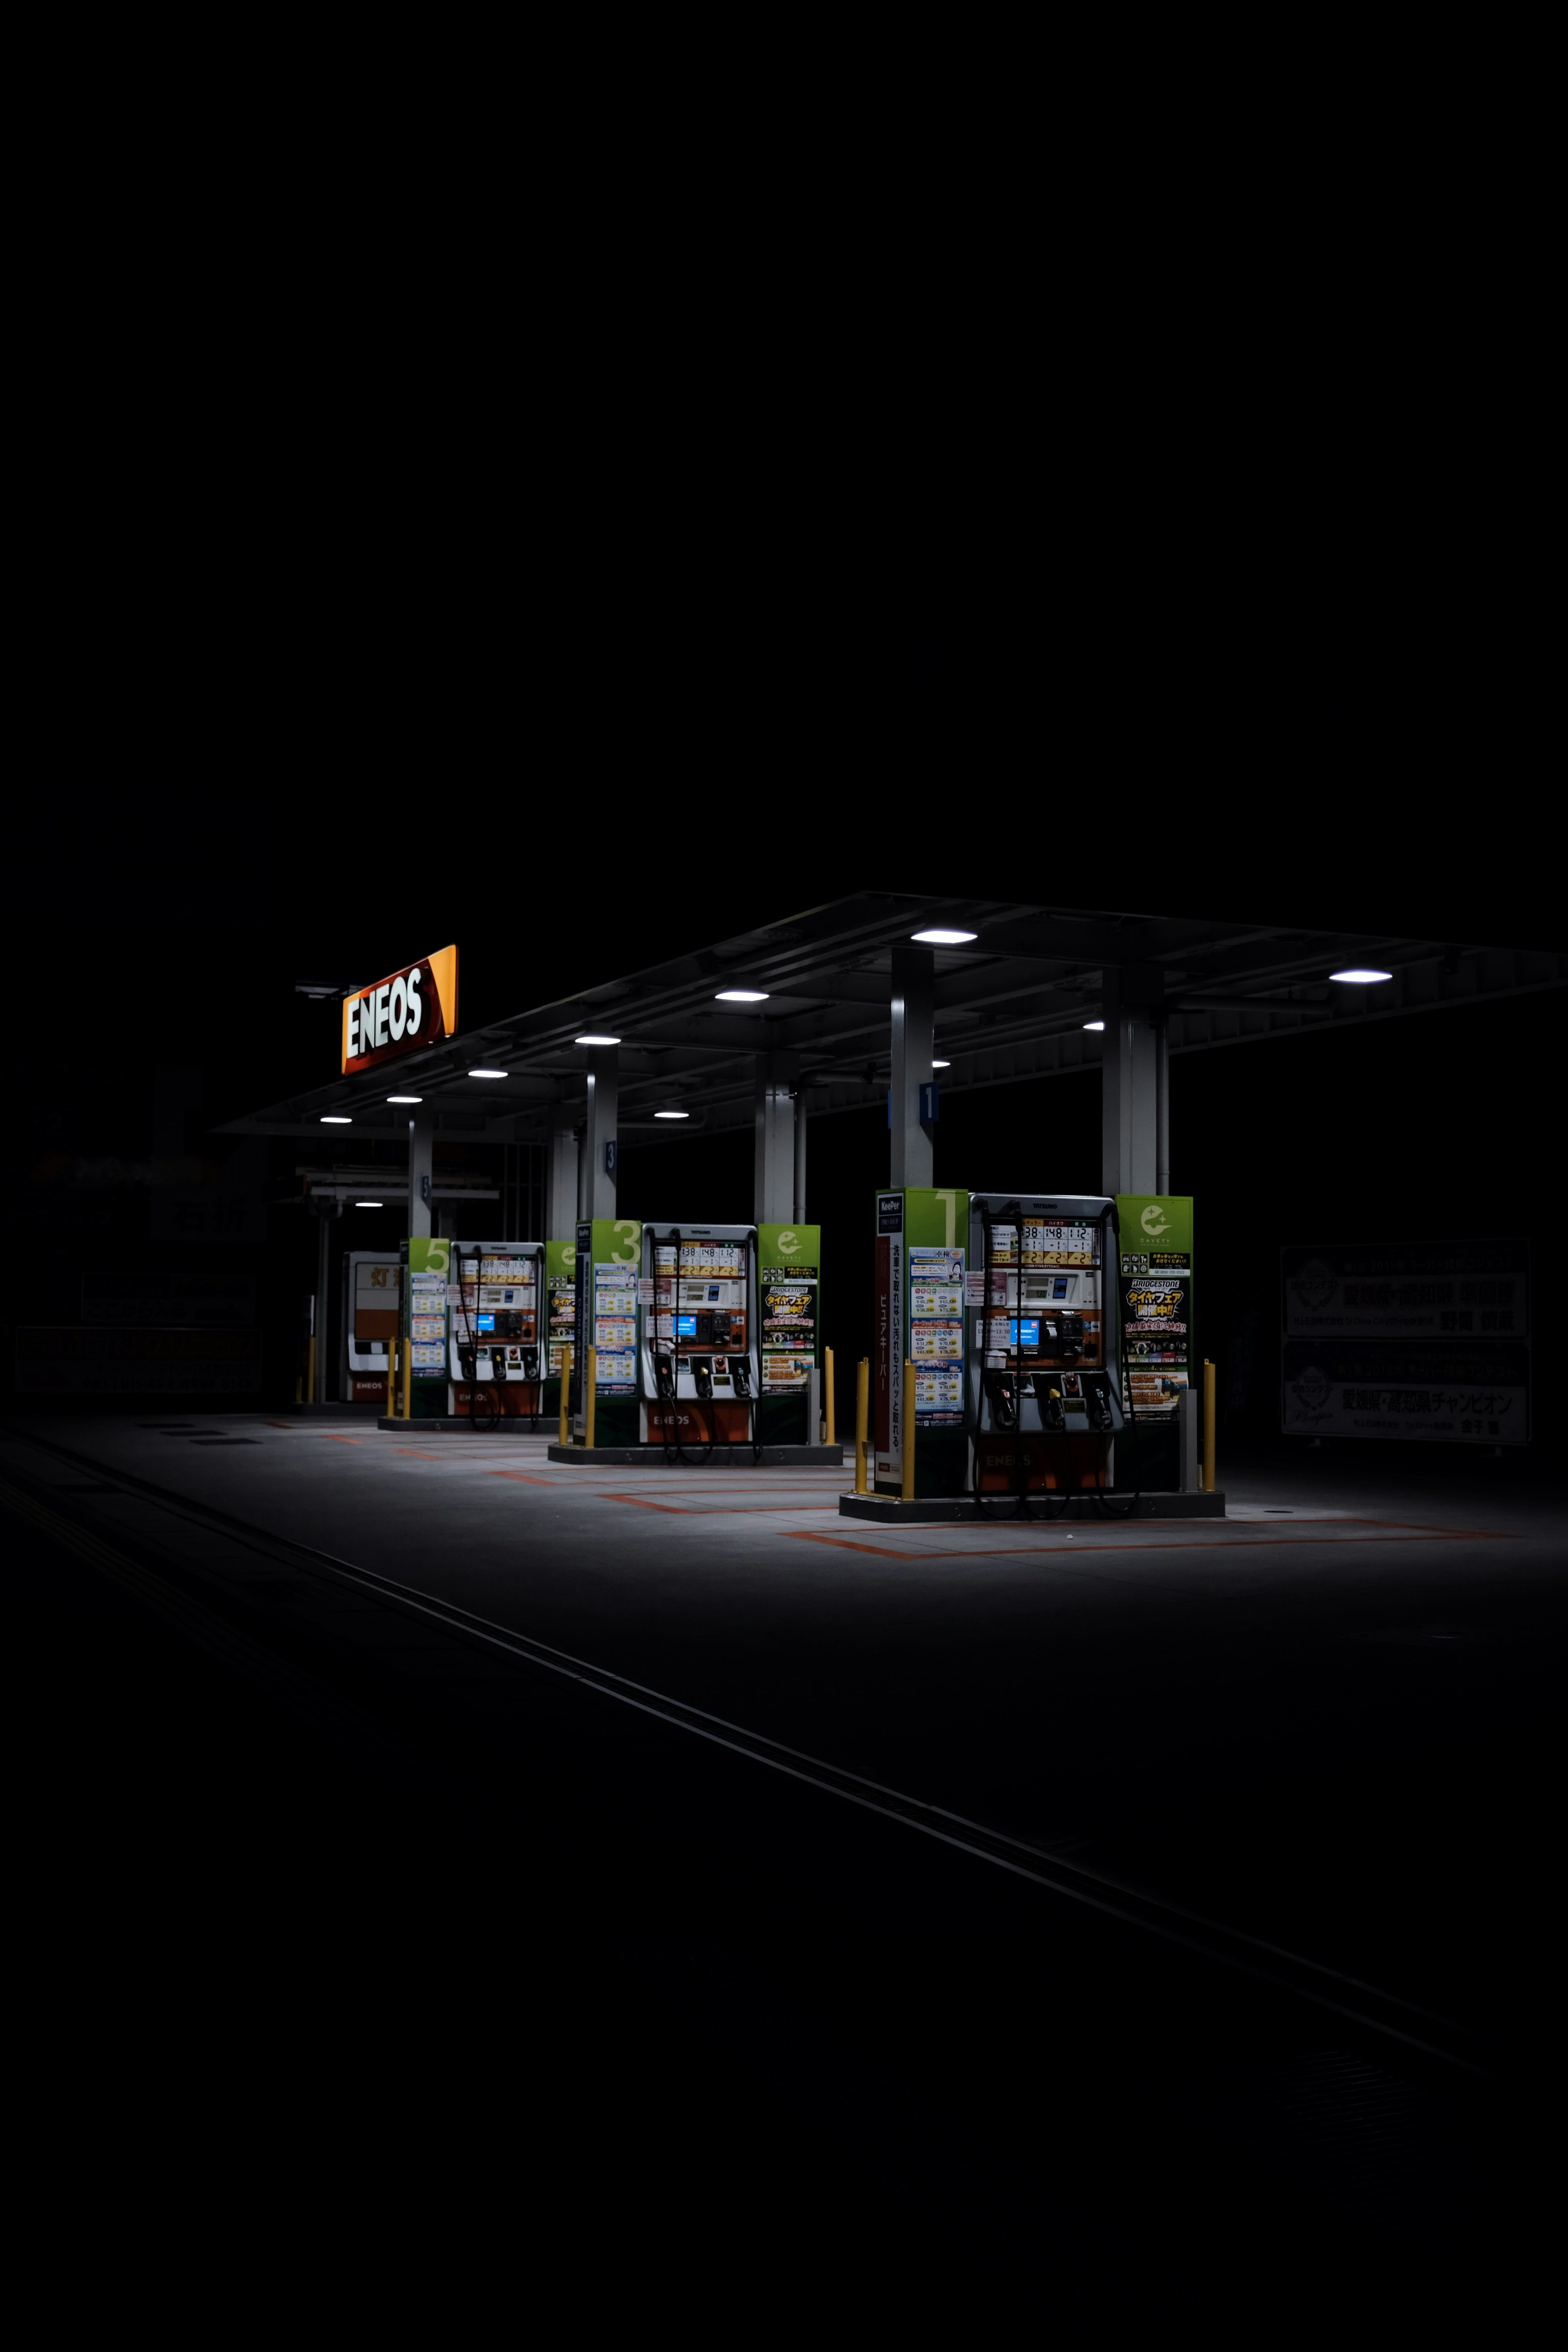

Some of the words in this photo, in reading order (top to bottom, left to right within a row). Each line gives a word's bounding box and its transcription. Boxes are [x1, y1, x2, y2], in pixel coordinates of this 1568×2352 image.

[347, 968, 422, 1059] ENEOS
[925, 1087, 932, 1118] 1
[607, 1143, 614, 1169] 3
[935, 1190, 955, 1247] 1
[611, 1220, 641, 1264] 3
[1046, 1228, 1062, 1239] 148
[1070, 1228, 1087, 1239] 112
[425, 1238, 450, 1273] 5
[682, 1247, 695, 1256] 138
[702, 1248, 715, 1257] 148
[721, 1249, 734, 1257] 112
[767, 1295, 811, 1305] タイヤフェア
[1128, 1291, 1182, 1304] タイヤフェア
